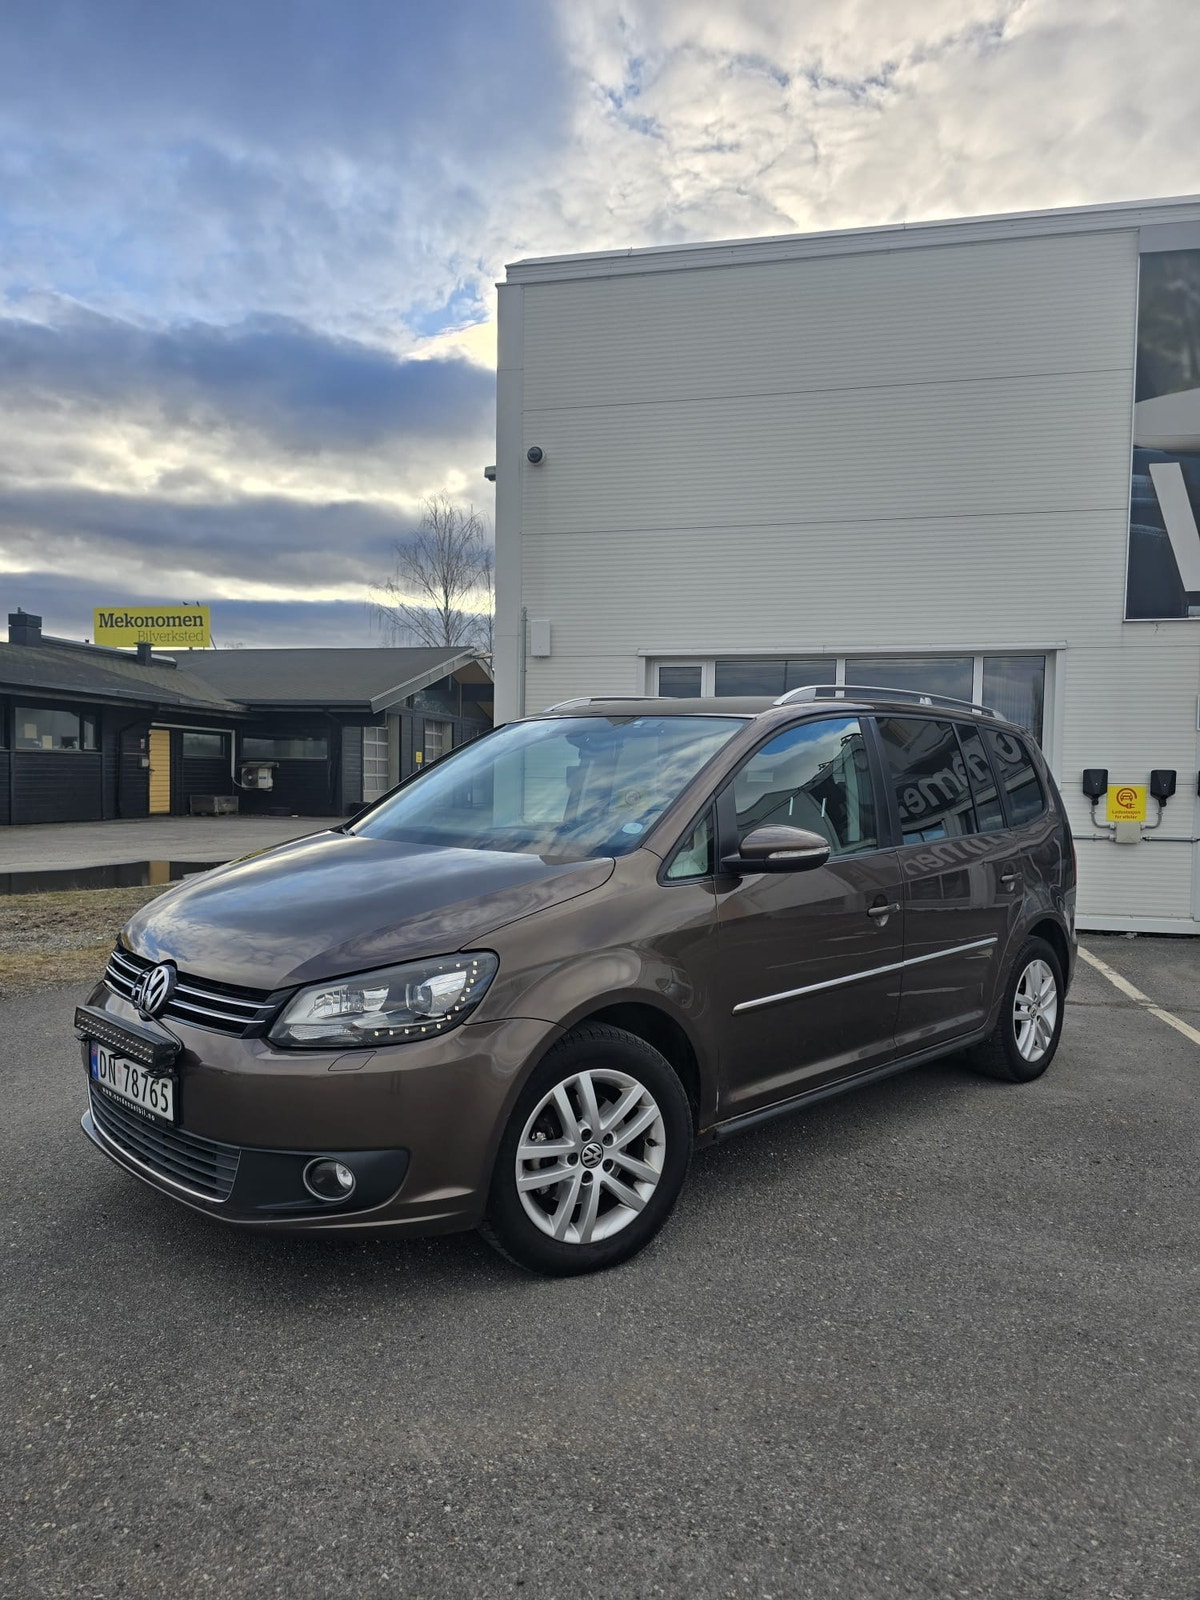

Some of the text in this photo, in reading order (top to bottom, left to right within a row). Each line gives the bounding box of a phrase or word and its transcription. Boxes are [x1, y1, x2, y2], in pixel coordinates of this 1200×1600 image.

[98, 613, 204, 628] Mekonomen
[137, 630, 204, 642] Bilverksted
[99, 1050, 169, 1113] DN 78765
